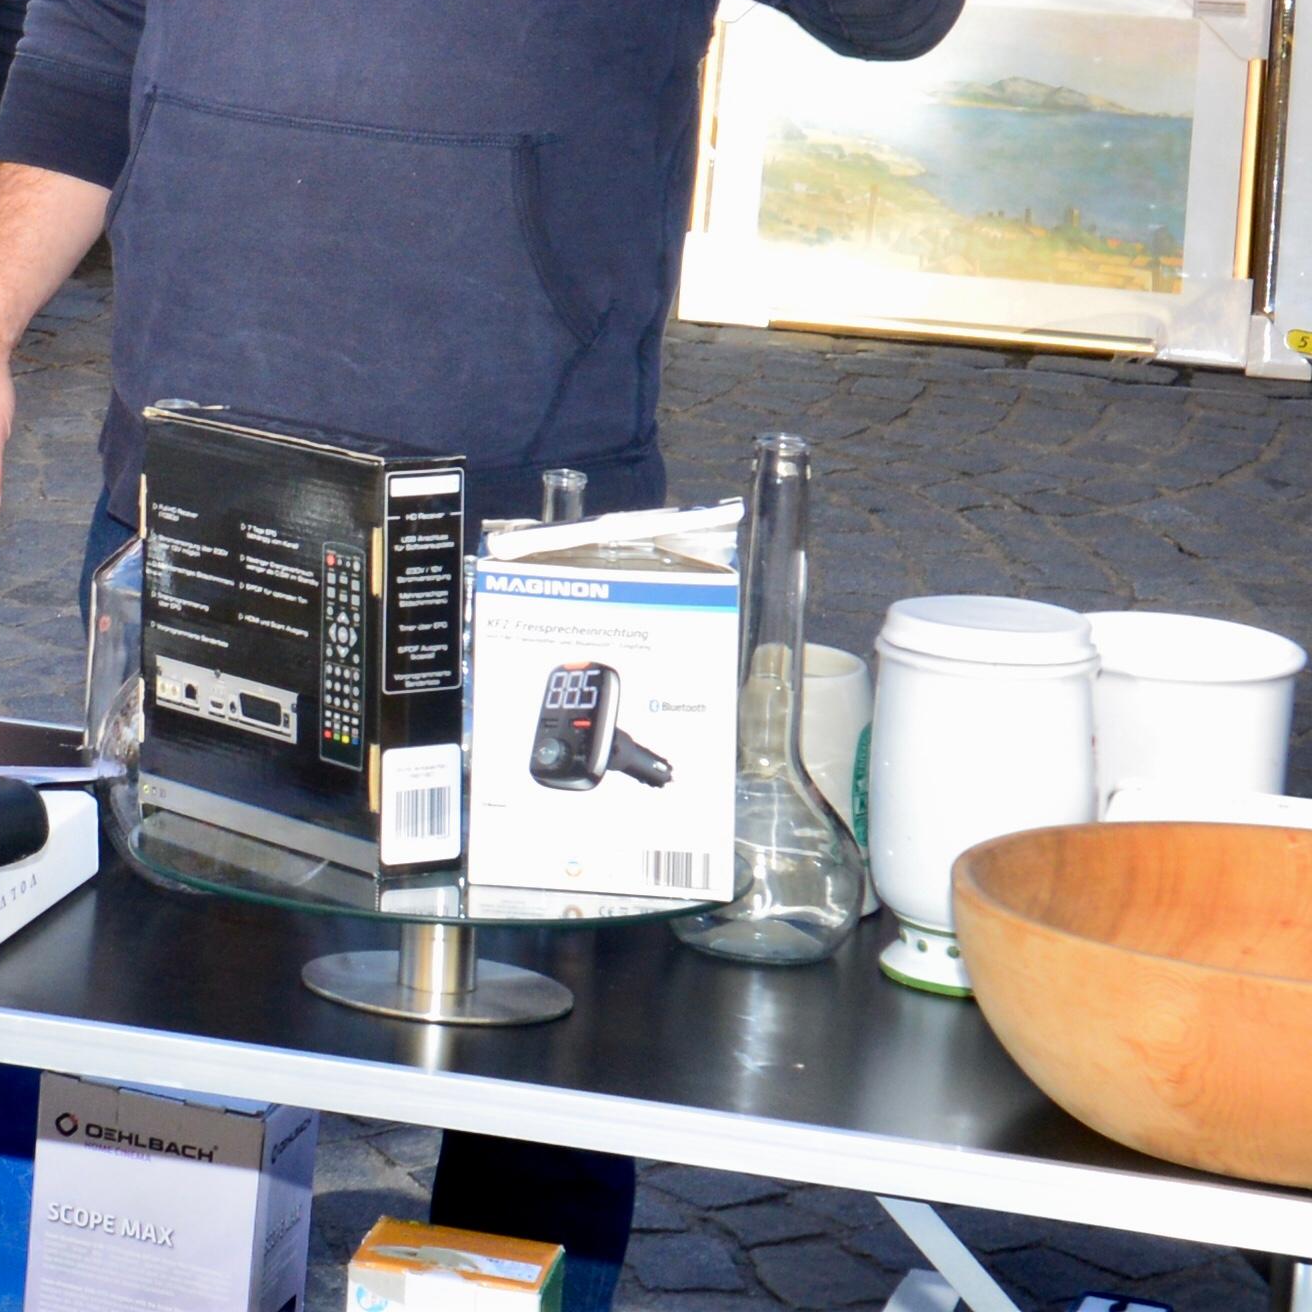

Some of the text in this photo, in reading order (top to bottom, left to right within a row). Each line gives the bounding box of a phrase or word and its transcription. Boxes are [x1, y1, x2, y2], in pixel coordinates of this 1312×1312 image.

[485, 575, 610, 600] MAGINON
[84, 1122, 215, 1164] OEHLBACH
[47, 1201, 176, 1249] SCOPE MAX
